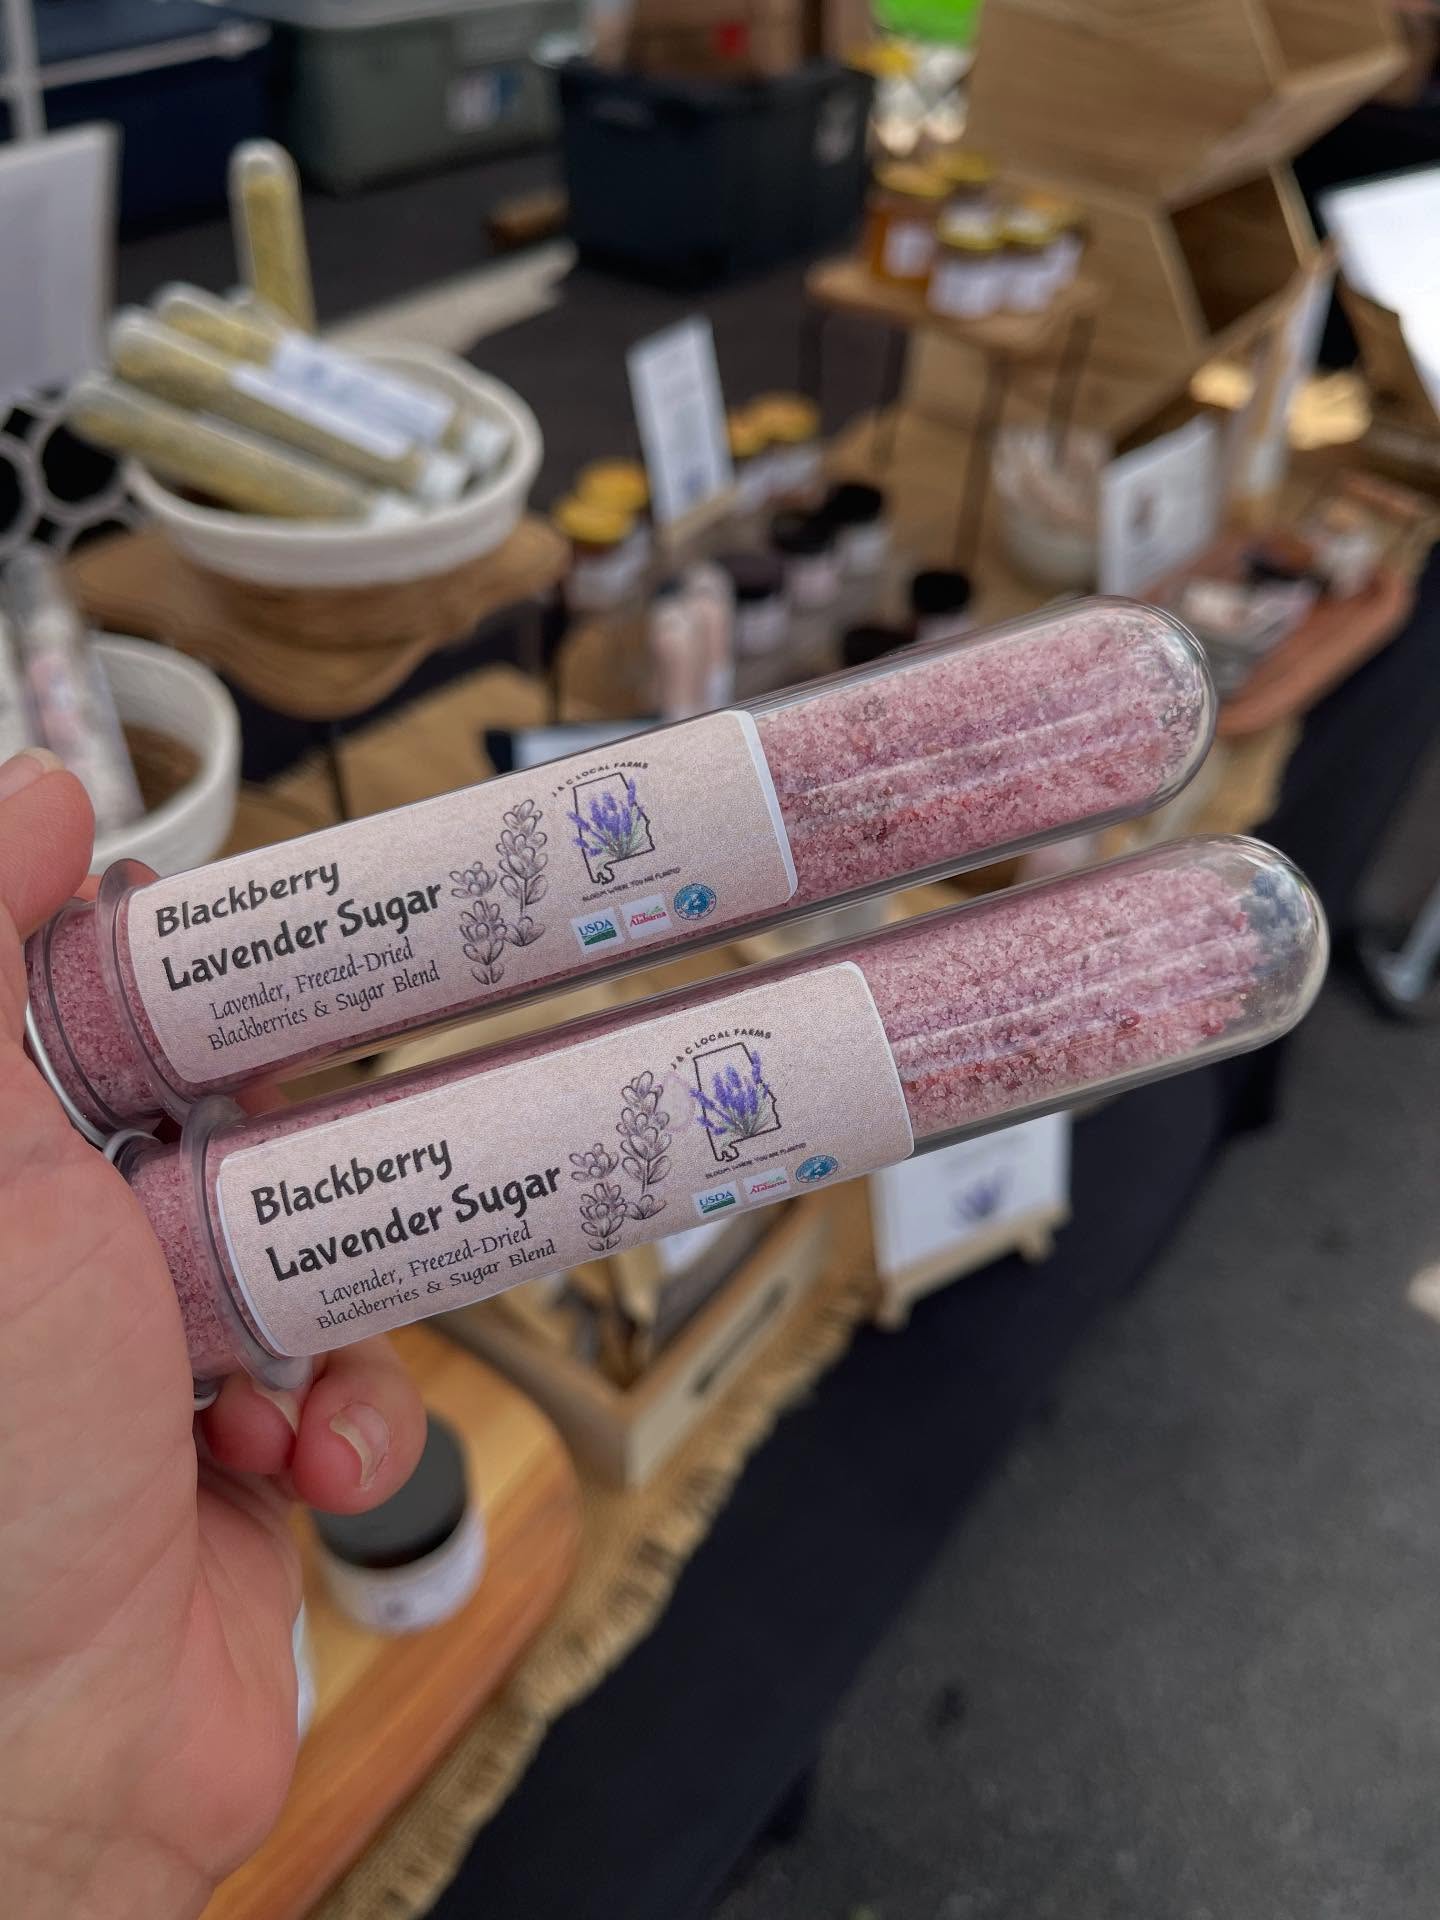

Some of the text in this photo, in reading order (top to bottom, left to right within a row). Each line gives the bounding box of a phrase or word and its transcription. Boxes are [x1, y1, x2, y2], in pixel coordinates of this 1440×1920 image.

[576, 764, 610, 780] LOCAL
[614, 761, 649, 769] FARMS
[156, 862, 340, 937] Blackberry
[161, 883, 441, 991] Lavender Sugar
[578, 919, 613, 936] USDA
[208, 960, 441, 1051] Blackberries & Sugar Blend
[209, 936, 414, 1020] Lavender, Freezed-Dried
[685, 1046, 693, 1054] C
[694, 1030, 730, 1048] LOCAL
[734, 1028, 771, 1039] FARMS
[251, 1139, 452, 1225] Blackberry
[265, 1167, 560, 1281] Lavender Sugar
[699, 1189, 733, 1207] USDA
[316, 1239, 556, 1329] Blackberries & Sugar Blend
[320, 1220, 533, 1305] Lavender, Freezed-Dried
